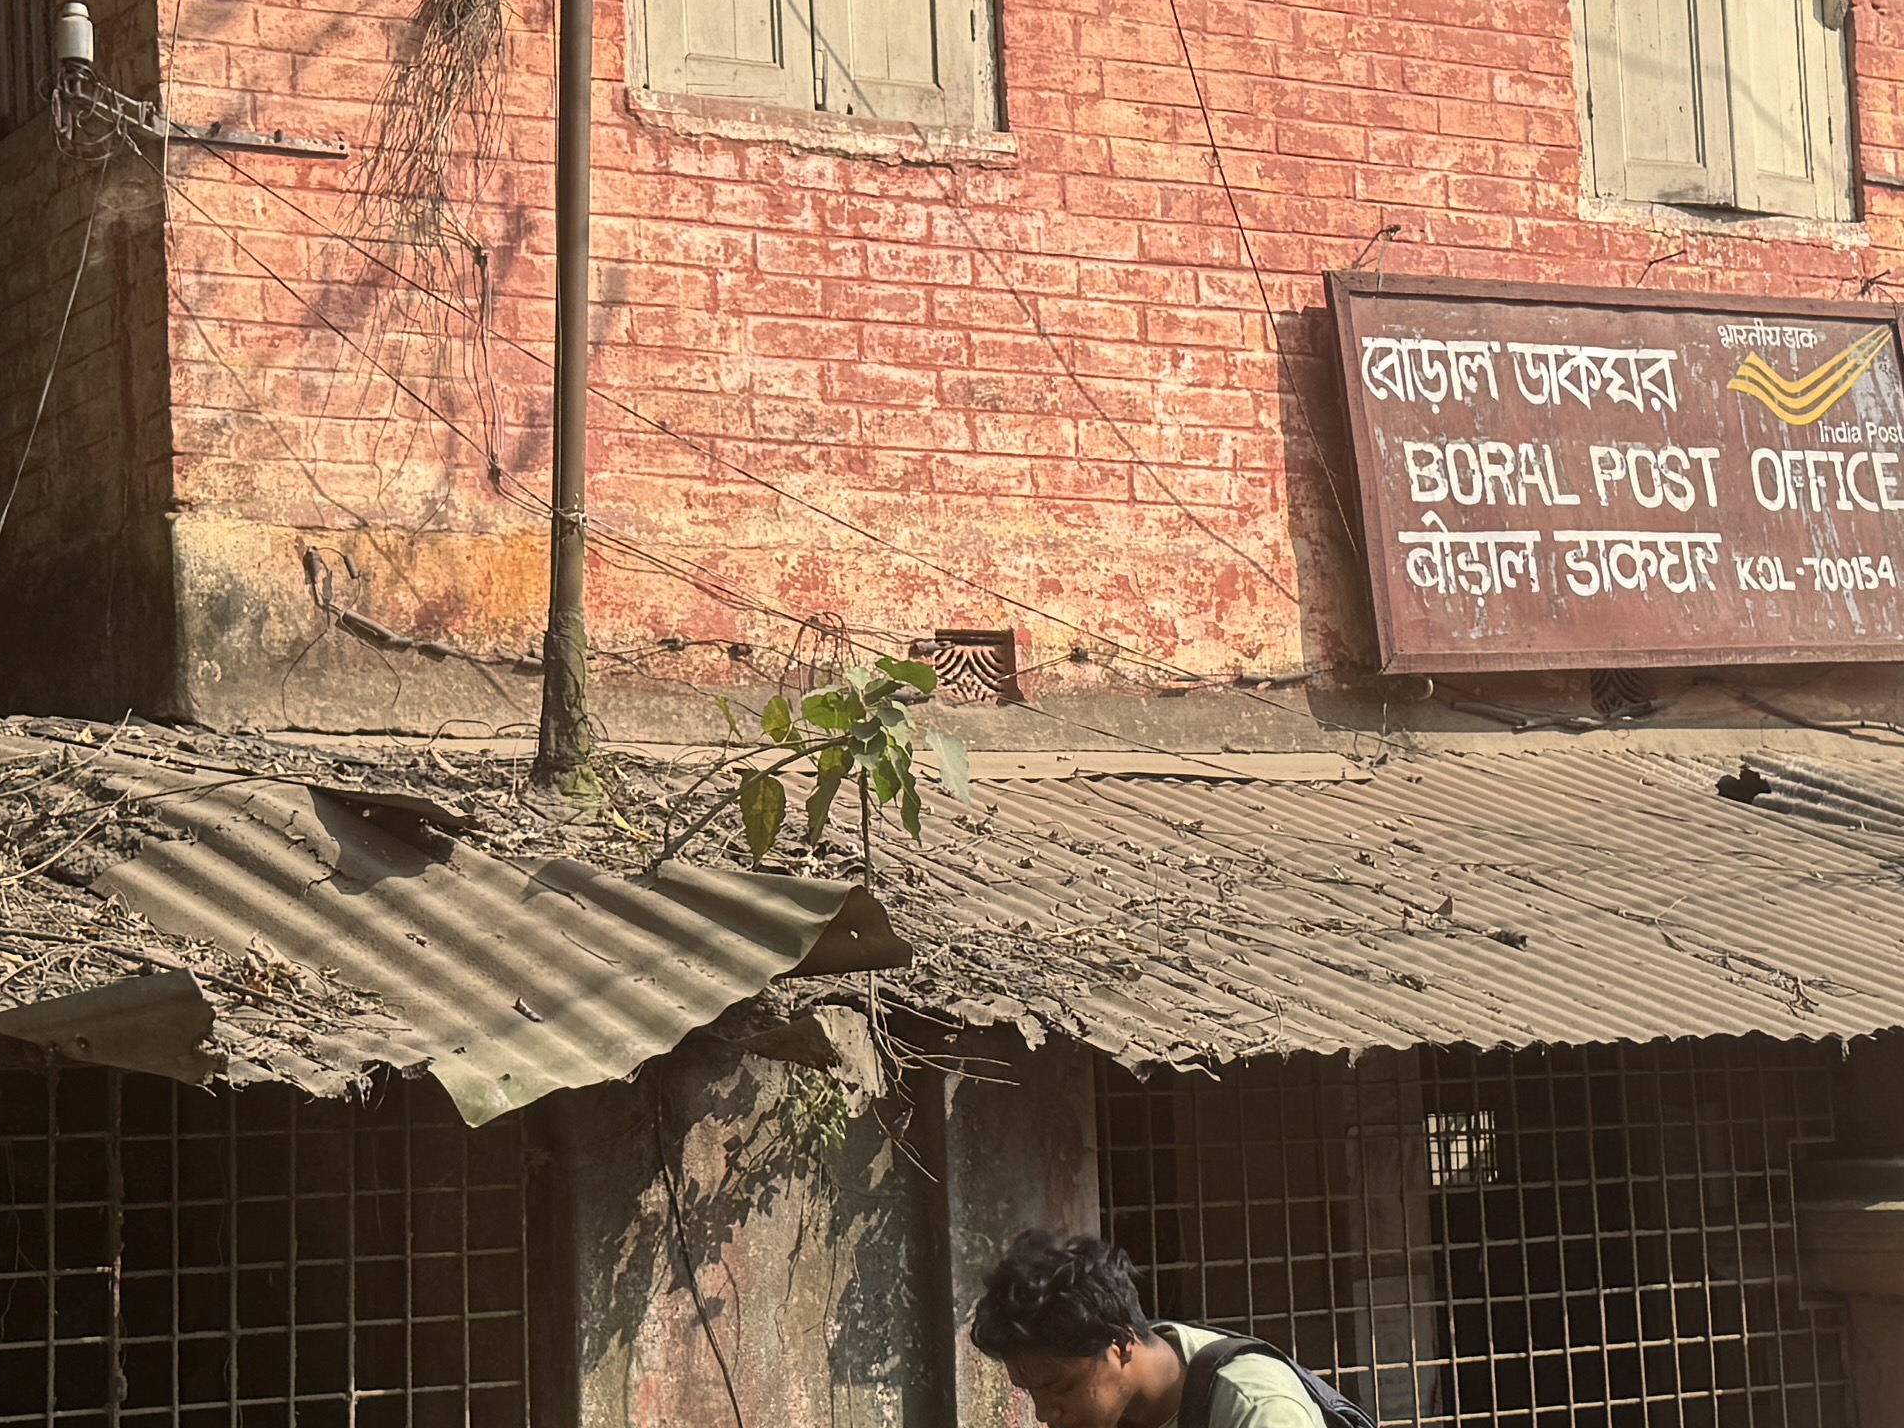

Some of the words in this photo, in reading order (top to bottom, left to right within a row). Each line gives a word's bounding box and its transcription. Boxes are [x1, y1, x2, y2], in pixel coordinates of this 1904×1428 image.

[1717, 318, 1781, 349] भारतीय
[1783, 326, 1818, 350] डाक
[1361, 336, 1501, 414] বোড়াল
[1507, 342, 1678, 413] ডাকঘর
[1817, 420, 1862, 444] India
[1403, 440, 1582, 507] BORAL
[1589, 445, 1721, 512] POST
[1553, 530, 1723, 597] डाकघर
